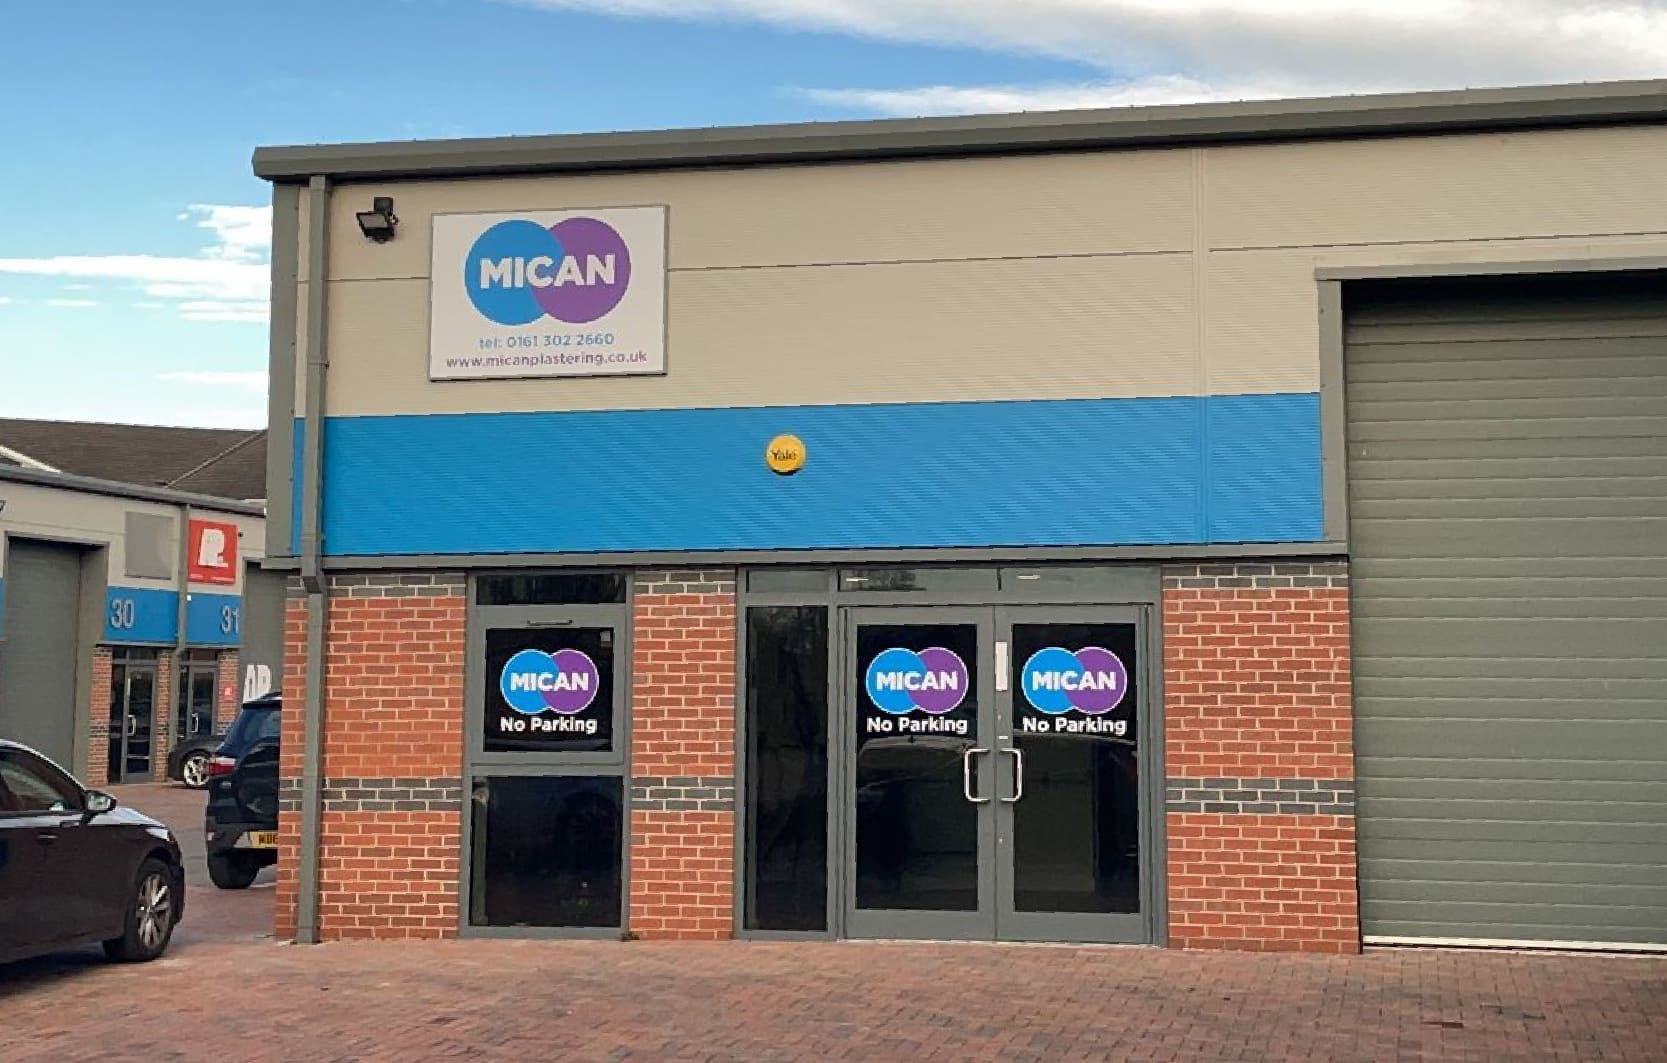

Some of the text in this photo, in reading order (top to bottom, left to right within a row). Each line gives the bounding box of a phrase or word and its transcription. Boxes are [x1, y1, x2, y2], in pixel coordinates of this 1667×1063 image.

[479, 254, 616, 289] MICAN
[479, 333, 614, 349] tel: 0161 302 2660
[446, 350, 648, 368] www.micanplastering.co.uk
[772, 449, 798, 461] Yale
[111, 598, 135, 629] 30
[221, 605, 240, 634] 31
[510, 672, 589, 691] MICAN
[876, 671, 958, 691] MICAN
[1032, 671, 1117, 691] MICAN
[500, 716, 598, 735] No Parking
[866, 716, 968, 735] No Parking
[1022, 716, 1127, 736] No Parking
